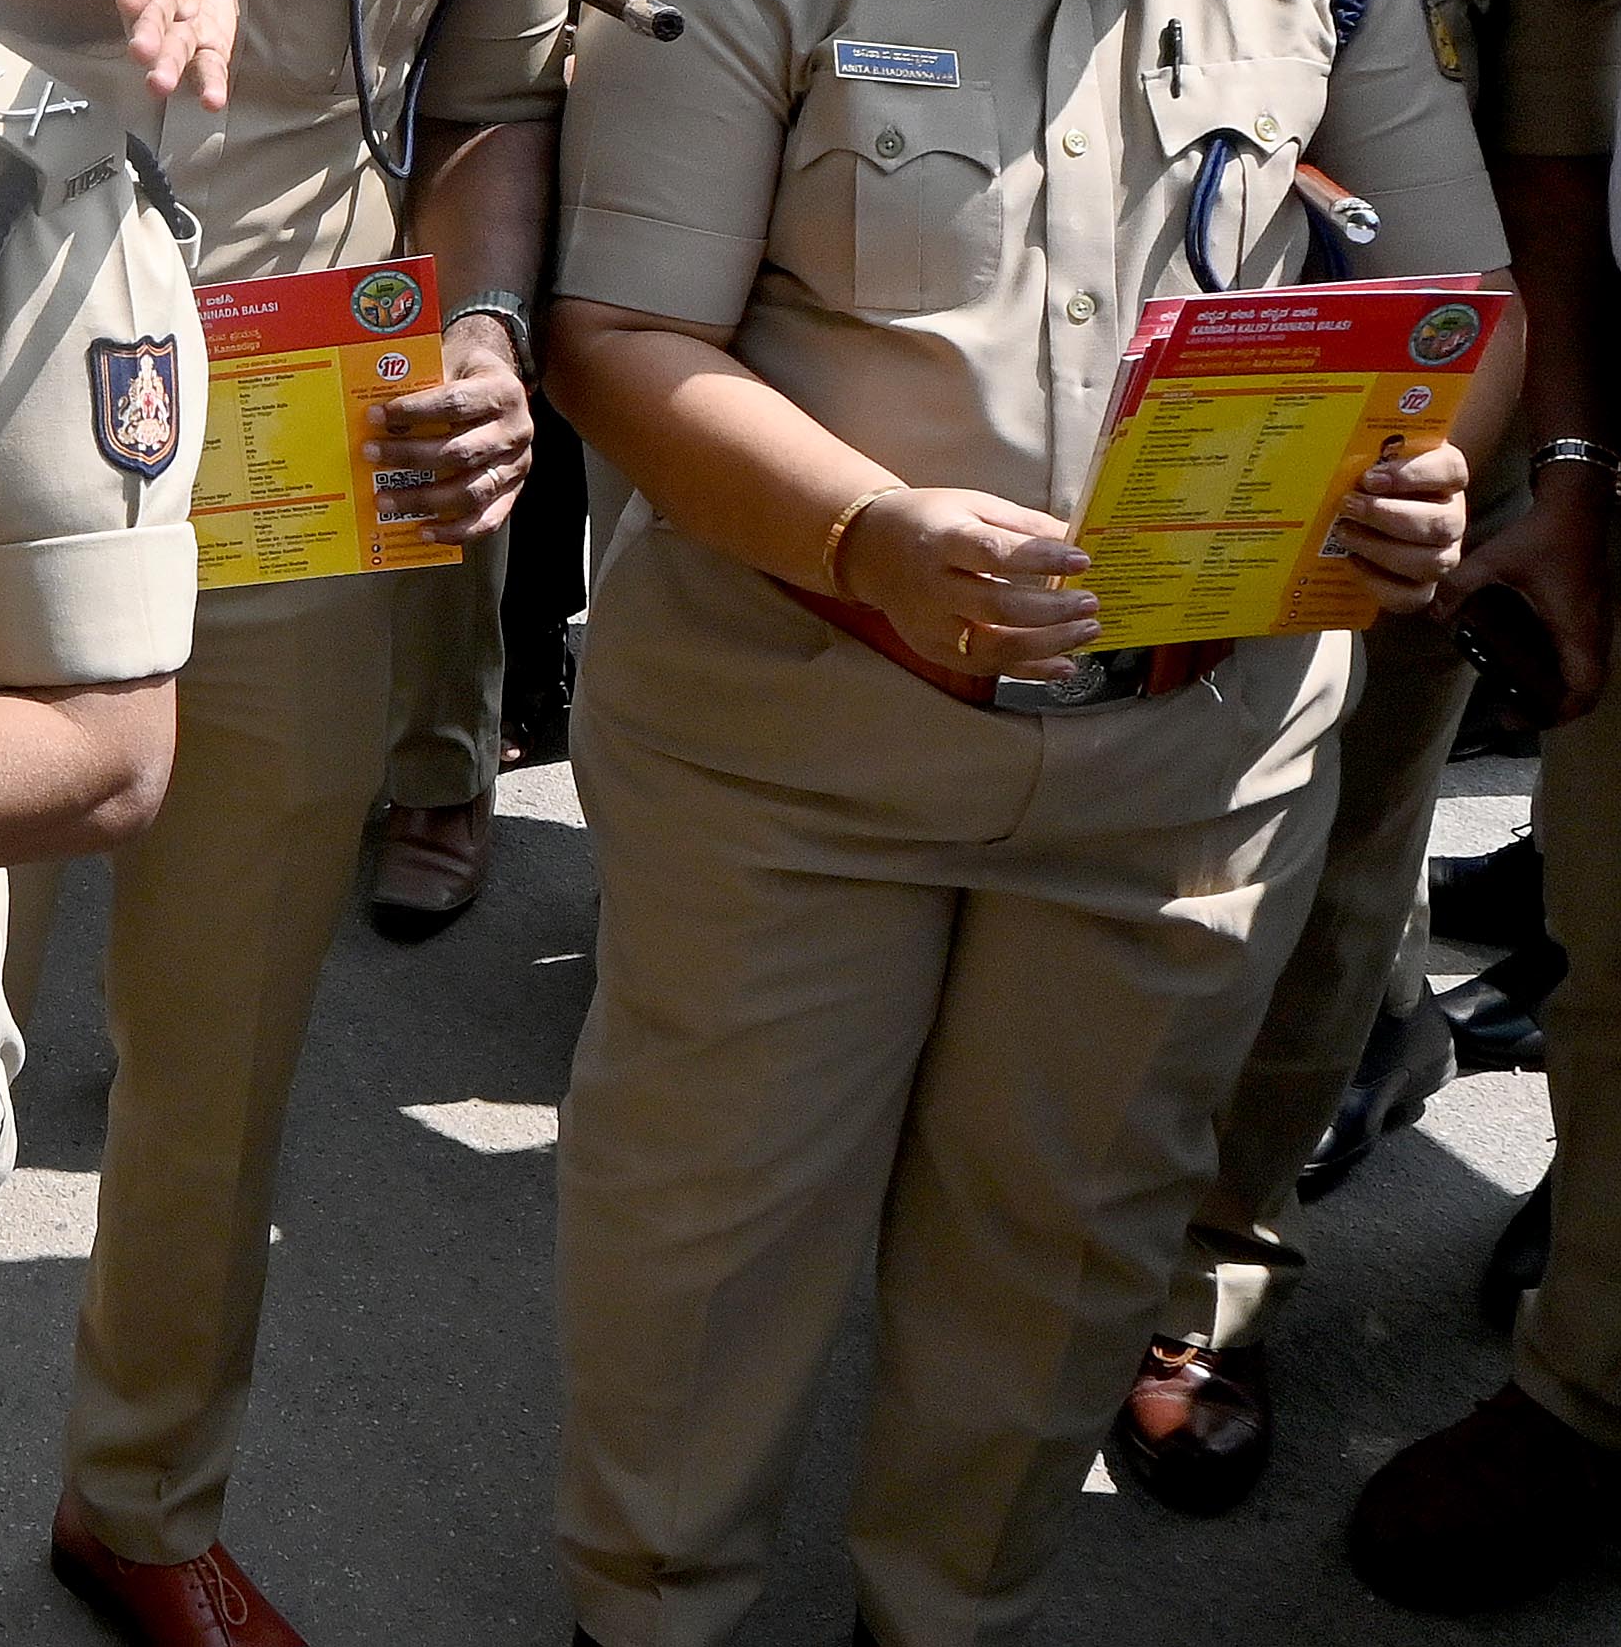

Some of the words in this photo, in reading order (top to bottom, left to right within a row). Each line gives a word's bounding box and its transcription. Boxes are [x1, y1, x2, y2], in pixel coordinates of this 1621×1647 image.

[241, 301, 279, 317] BALASI
[213, 341, 261, 356] Kannadiga
[382, 358, 405, 377] 112
